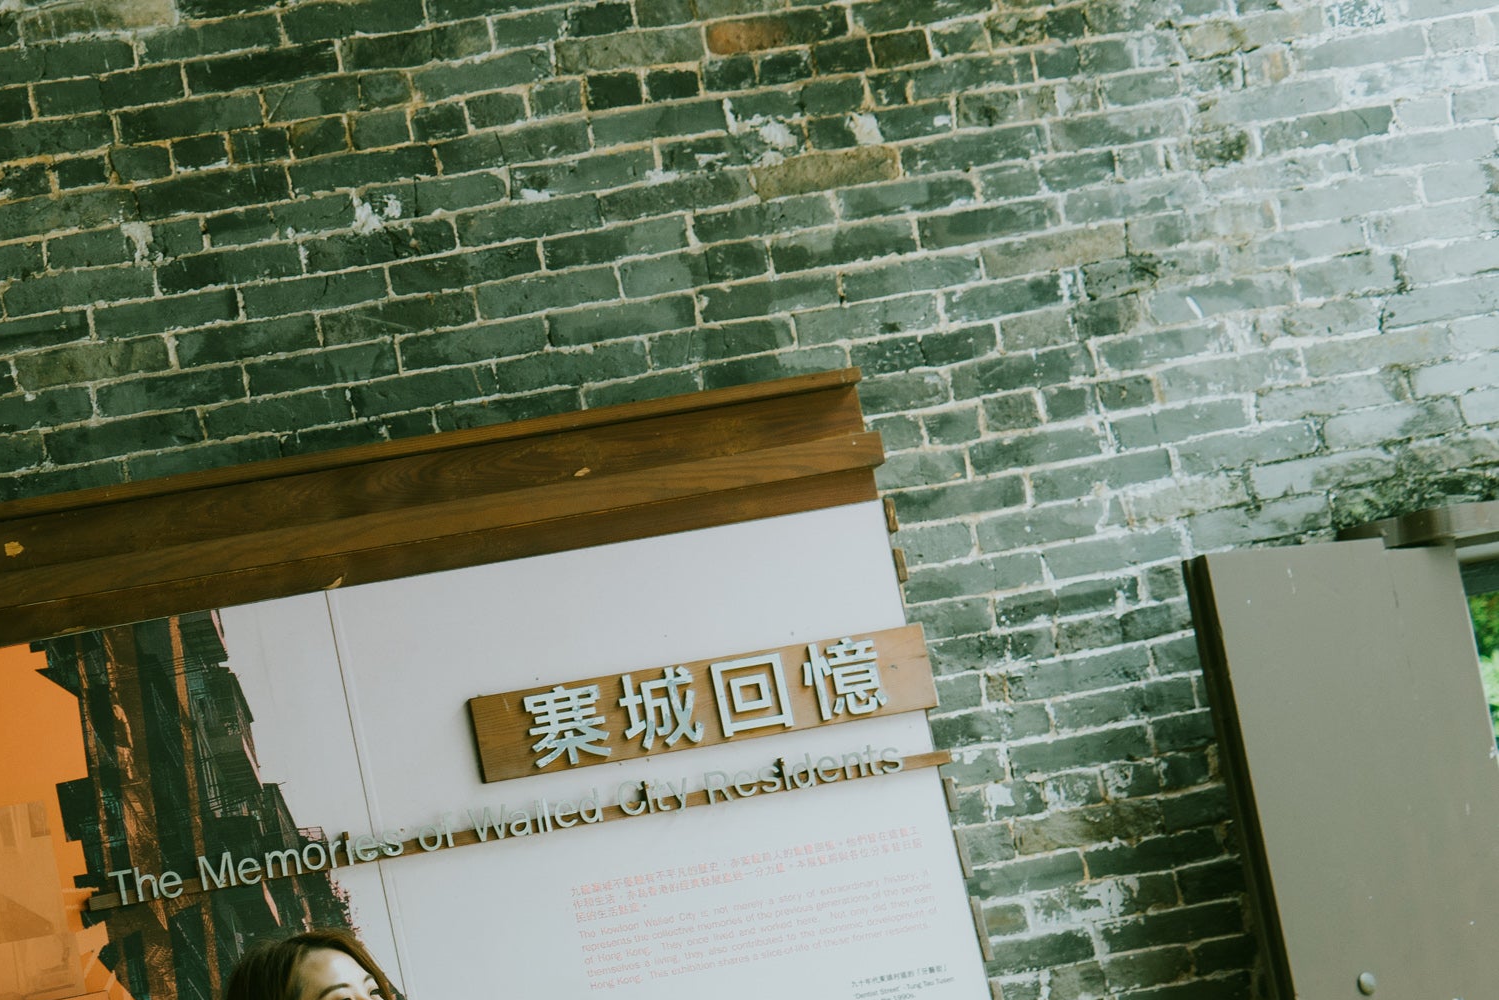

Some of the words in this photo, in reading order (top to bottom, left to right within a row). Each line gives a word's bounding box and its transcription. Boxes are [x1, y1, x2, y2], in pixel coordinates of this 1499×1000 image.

[523, 637, 889, 769] 寨城回憶
[107, 866, 184, 906] The
[198, 829, 405, 892] Memories
[418, 810, 455, 853] of
[467, 788, 604, 843] Walled
[617, 777, 688, 816] City
[704, 744, 905, 806] Residents
[599, 920, 641, 936] Kowloon
[642, 914, 675, 928] Walled
[678, 911, 696, 922] City
